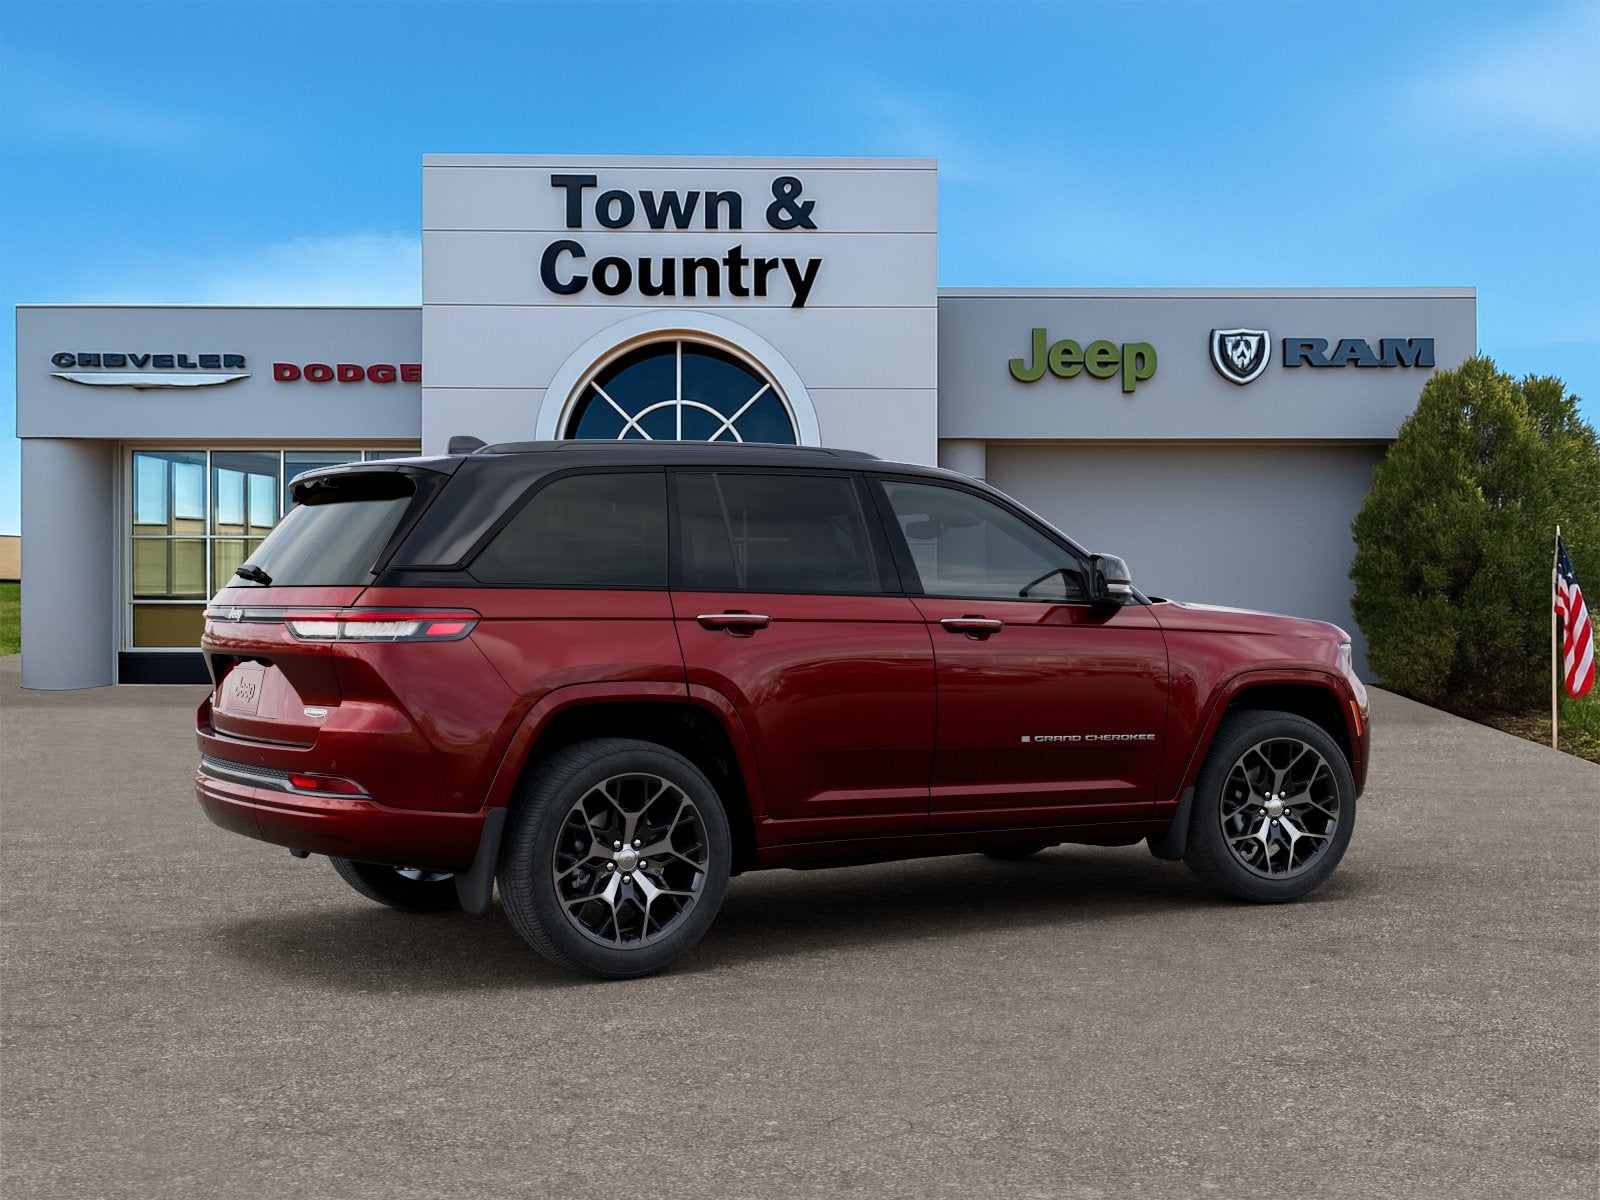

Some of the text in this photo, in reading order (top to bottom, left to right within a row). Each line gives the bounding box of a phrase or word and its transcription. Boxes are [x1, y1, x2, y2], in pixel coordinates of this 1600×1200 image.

[550, 174, 818, 230] Town &
[540, 239, 822, 308] Country
[273, 363, 422, 383] DODGE
[1008, 327, 1158, 393] Jeep
[1282, 337, 1436, 368] RAM
